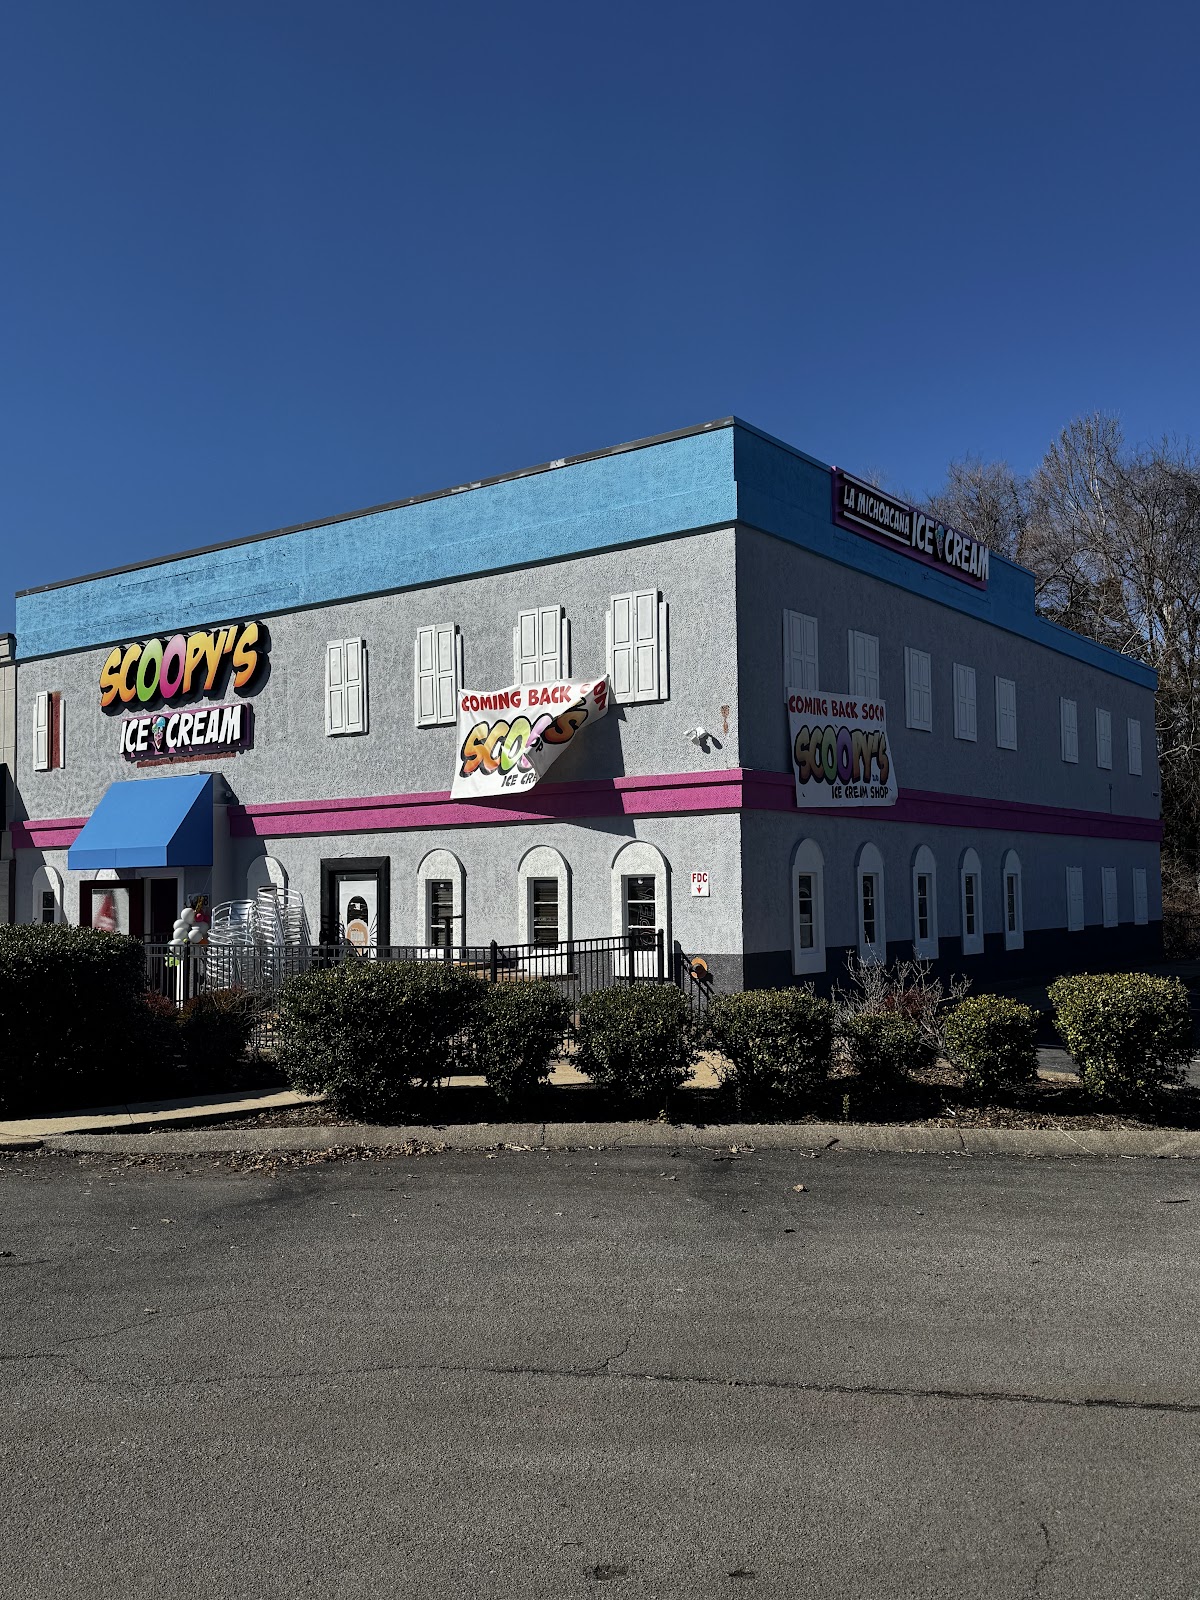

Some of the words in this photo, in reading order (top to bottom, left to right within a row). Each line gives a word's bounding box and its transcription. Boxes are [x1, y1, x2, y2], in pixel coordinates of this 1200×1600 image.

[844, 485, 855, 509] LA
[857, 492, 910, 536] MICHOACANA
[911, 511, 935, 555] ICE
[944, 528, 990, 582] CREAM
[100, 622, 262, 708] SCOOPY'S
[461, 690, 522, 712] COMING
[528, 685, 572, 706] BACK
[788, 695, 828, 717] COMING
[831, 700, 859, 720] BACK
[119, 717, 151, 754] ICE
[165, 704, 242, 749] CREAM
[500, 774, 519, 788] ICE
[831, 785, 842, 799] ICE
[870, 785, 889, 799] SHOP
[692, 872, 708, 883] FDC
